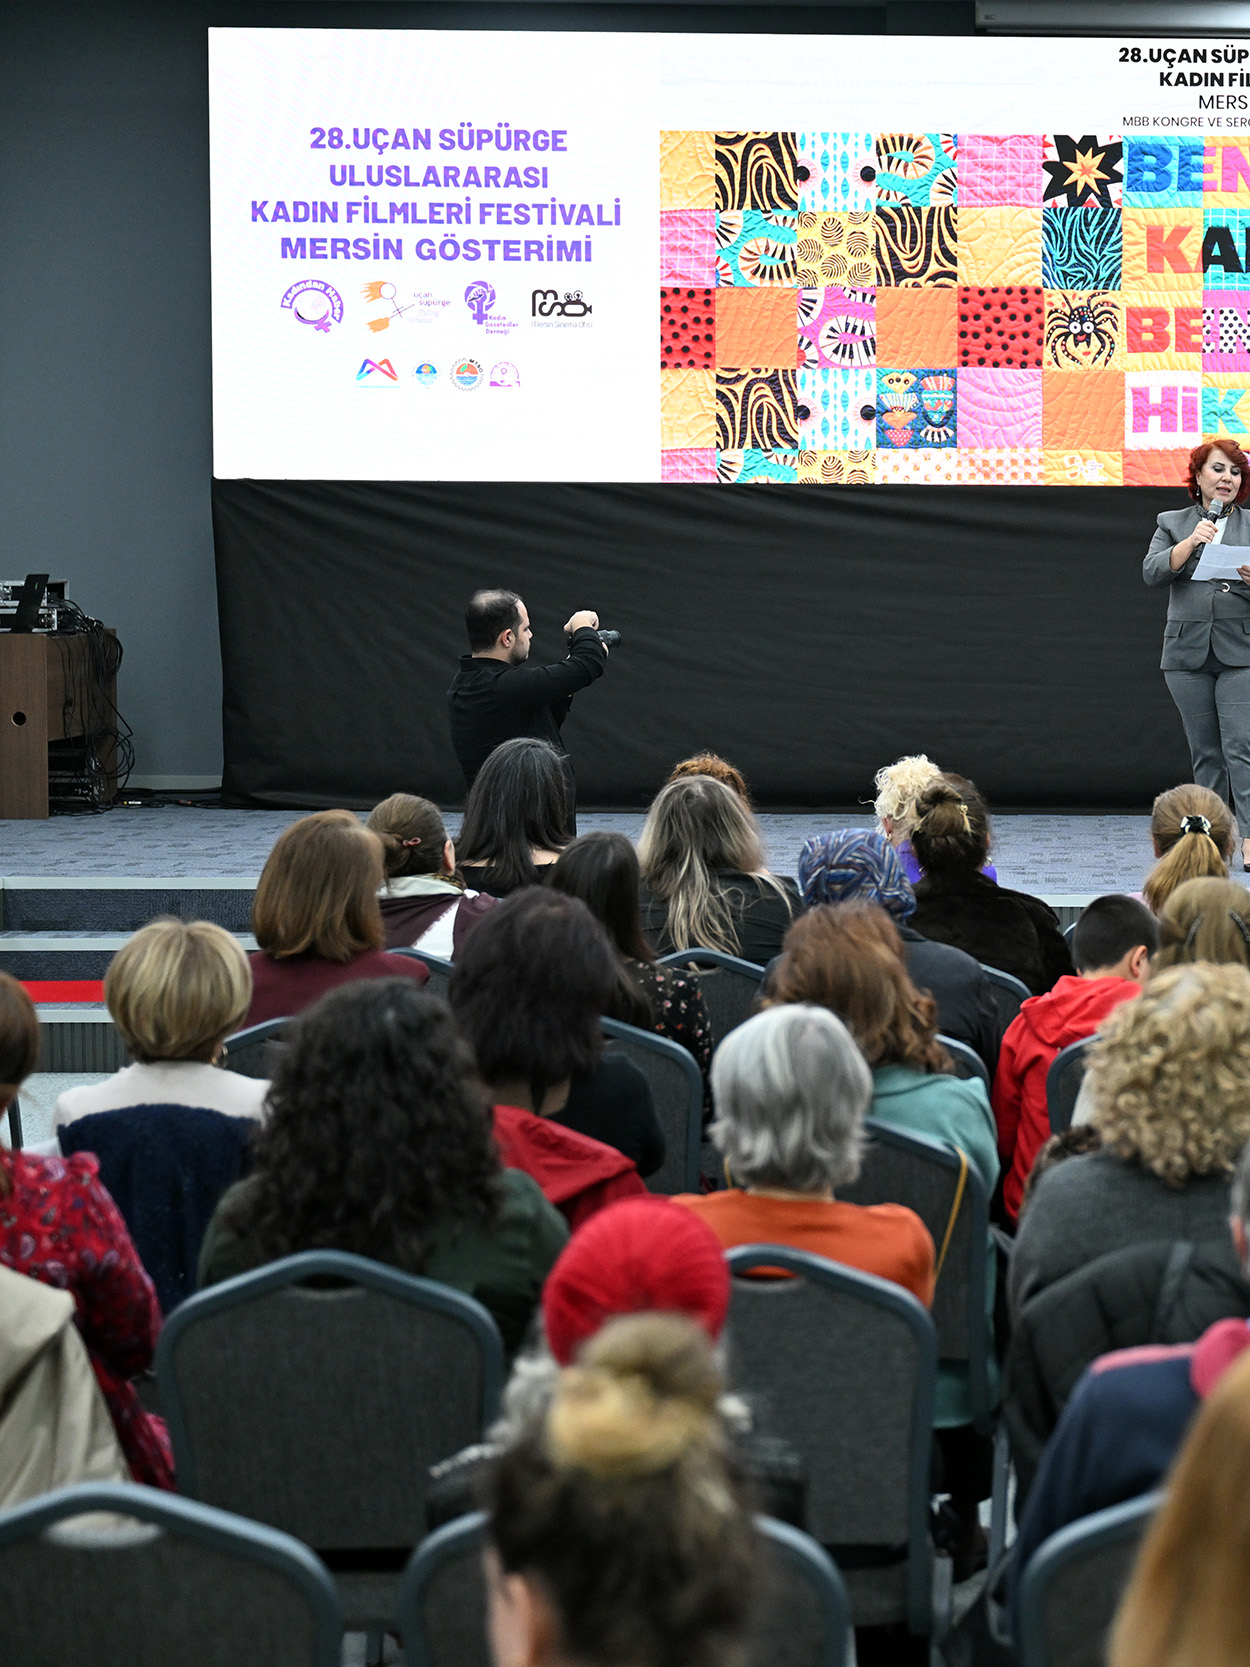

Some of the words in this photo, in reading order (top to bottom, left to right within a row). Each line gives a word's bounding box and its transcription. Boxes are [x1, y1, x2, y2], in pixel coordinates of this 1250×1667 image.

[1119, 48, 1207, 69] 28.UÇAN
[1160, 72, 1225, 88] KADIN
[1122, 116, 1150, 127] MBB
[1153, 116, 1204, 128] KONGRE
[1208, 117, 1222, 128] VE
[310, 127, 432, 156] 28.UÇAN
[439, 121, 568, 152] SÜPÜRGE
[329, 164, 548, 189] ULUSLARARASI
[251, 200, 339, 223] KADIN
[346, 194, 472, 225] FİLMLERİ
[479, 196, 621, 226] FESTİVALİ
[281, 233, 403, 261] MERSİN
[415, 233, 592, 262] GÖSTERİMİ
